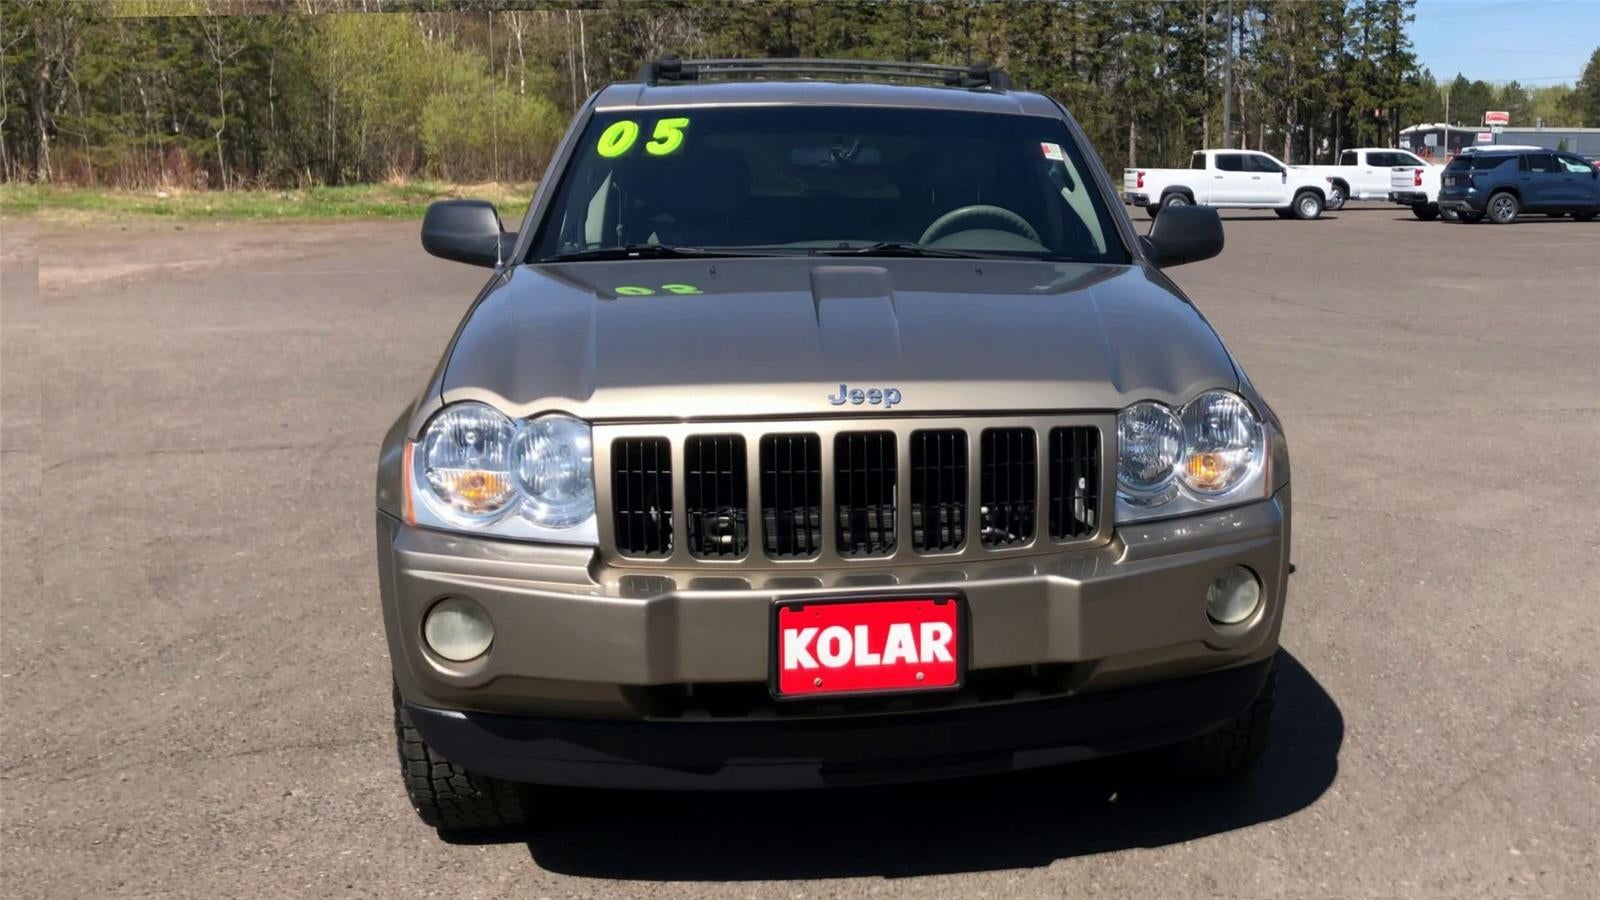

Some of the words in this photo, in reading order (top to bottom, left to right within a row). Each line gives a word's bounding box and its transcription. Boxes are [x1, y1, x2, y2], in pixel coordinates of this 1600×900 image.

[597, 117, 690, 158] 05
[827, 383, 902, 409] Jeep
[783, 621, 954, 670] KOLAR
